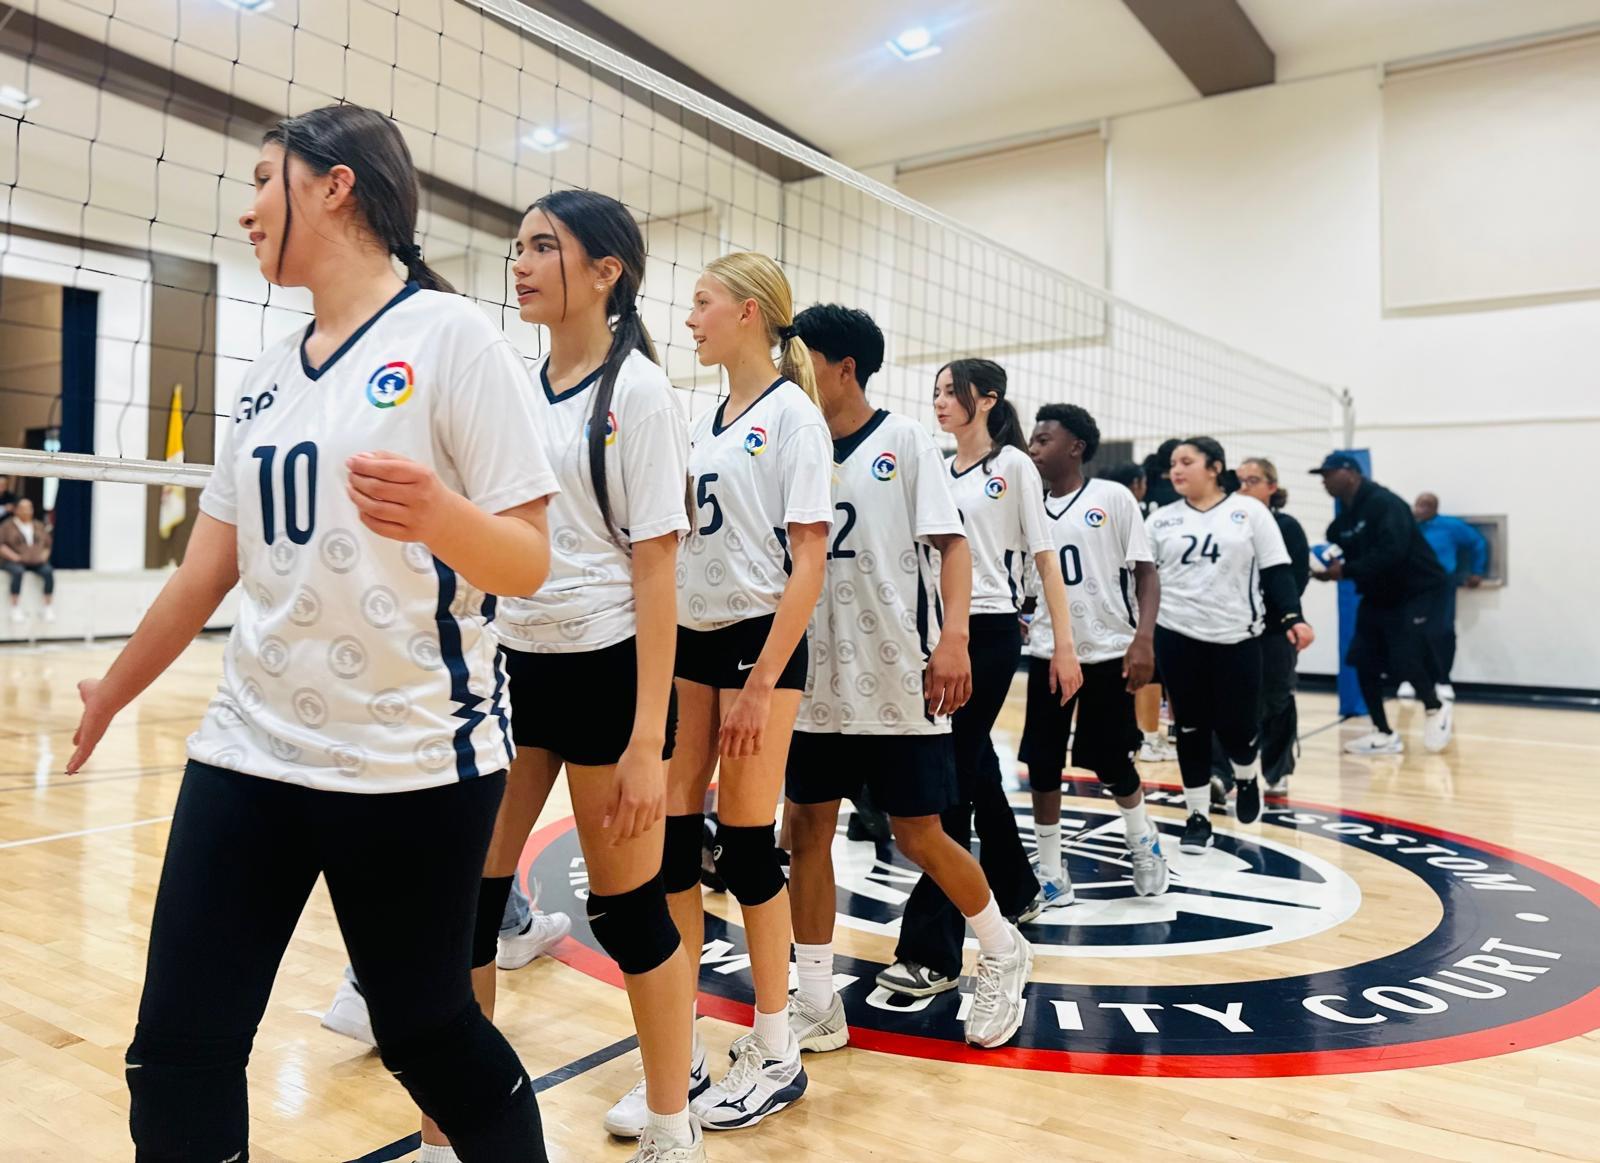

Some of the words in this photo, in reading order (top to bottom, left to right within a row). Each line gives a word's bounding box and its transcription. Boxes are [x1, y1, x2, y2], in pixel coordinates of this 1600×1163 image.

[252, 441, 318, 546] 10
[1181, 532, 1222, 565] 24
[1302, 937, 1563, 1026] COURT
